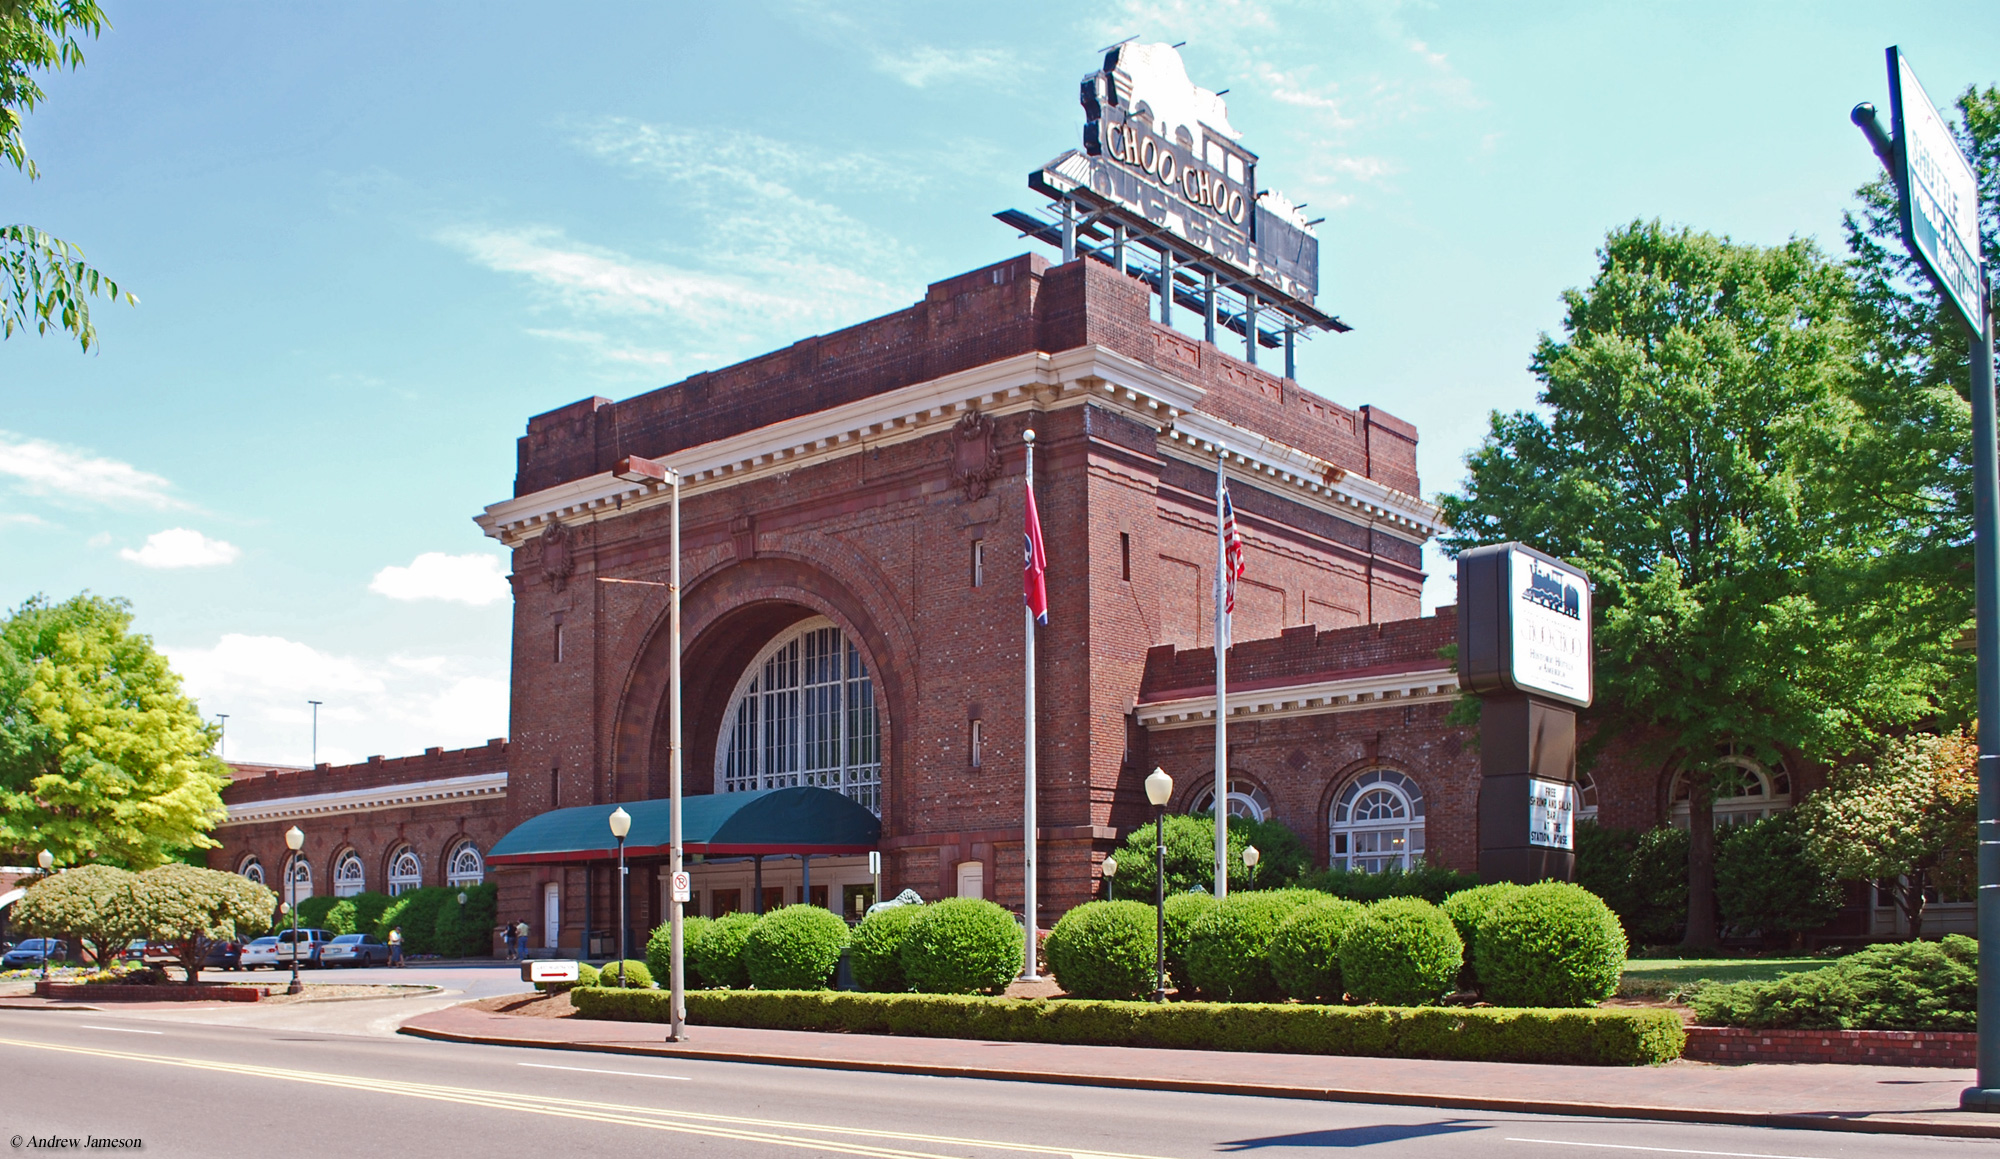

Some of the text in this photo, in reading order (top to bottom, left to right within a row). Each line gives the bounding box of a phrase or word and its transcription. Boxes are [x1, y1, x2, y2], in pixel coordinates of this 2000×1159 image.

[1911, 129, 1959, 228] SHUTTLE
[1546, 787, 1556, 798] FREE
[1549, 799, 1557, 809] AND
[1547, 811, 1556, 820] BAR
[1553, 823, 1562, 833] THE
[1531, 831, 1550, 843] STATION
